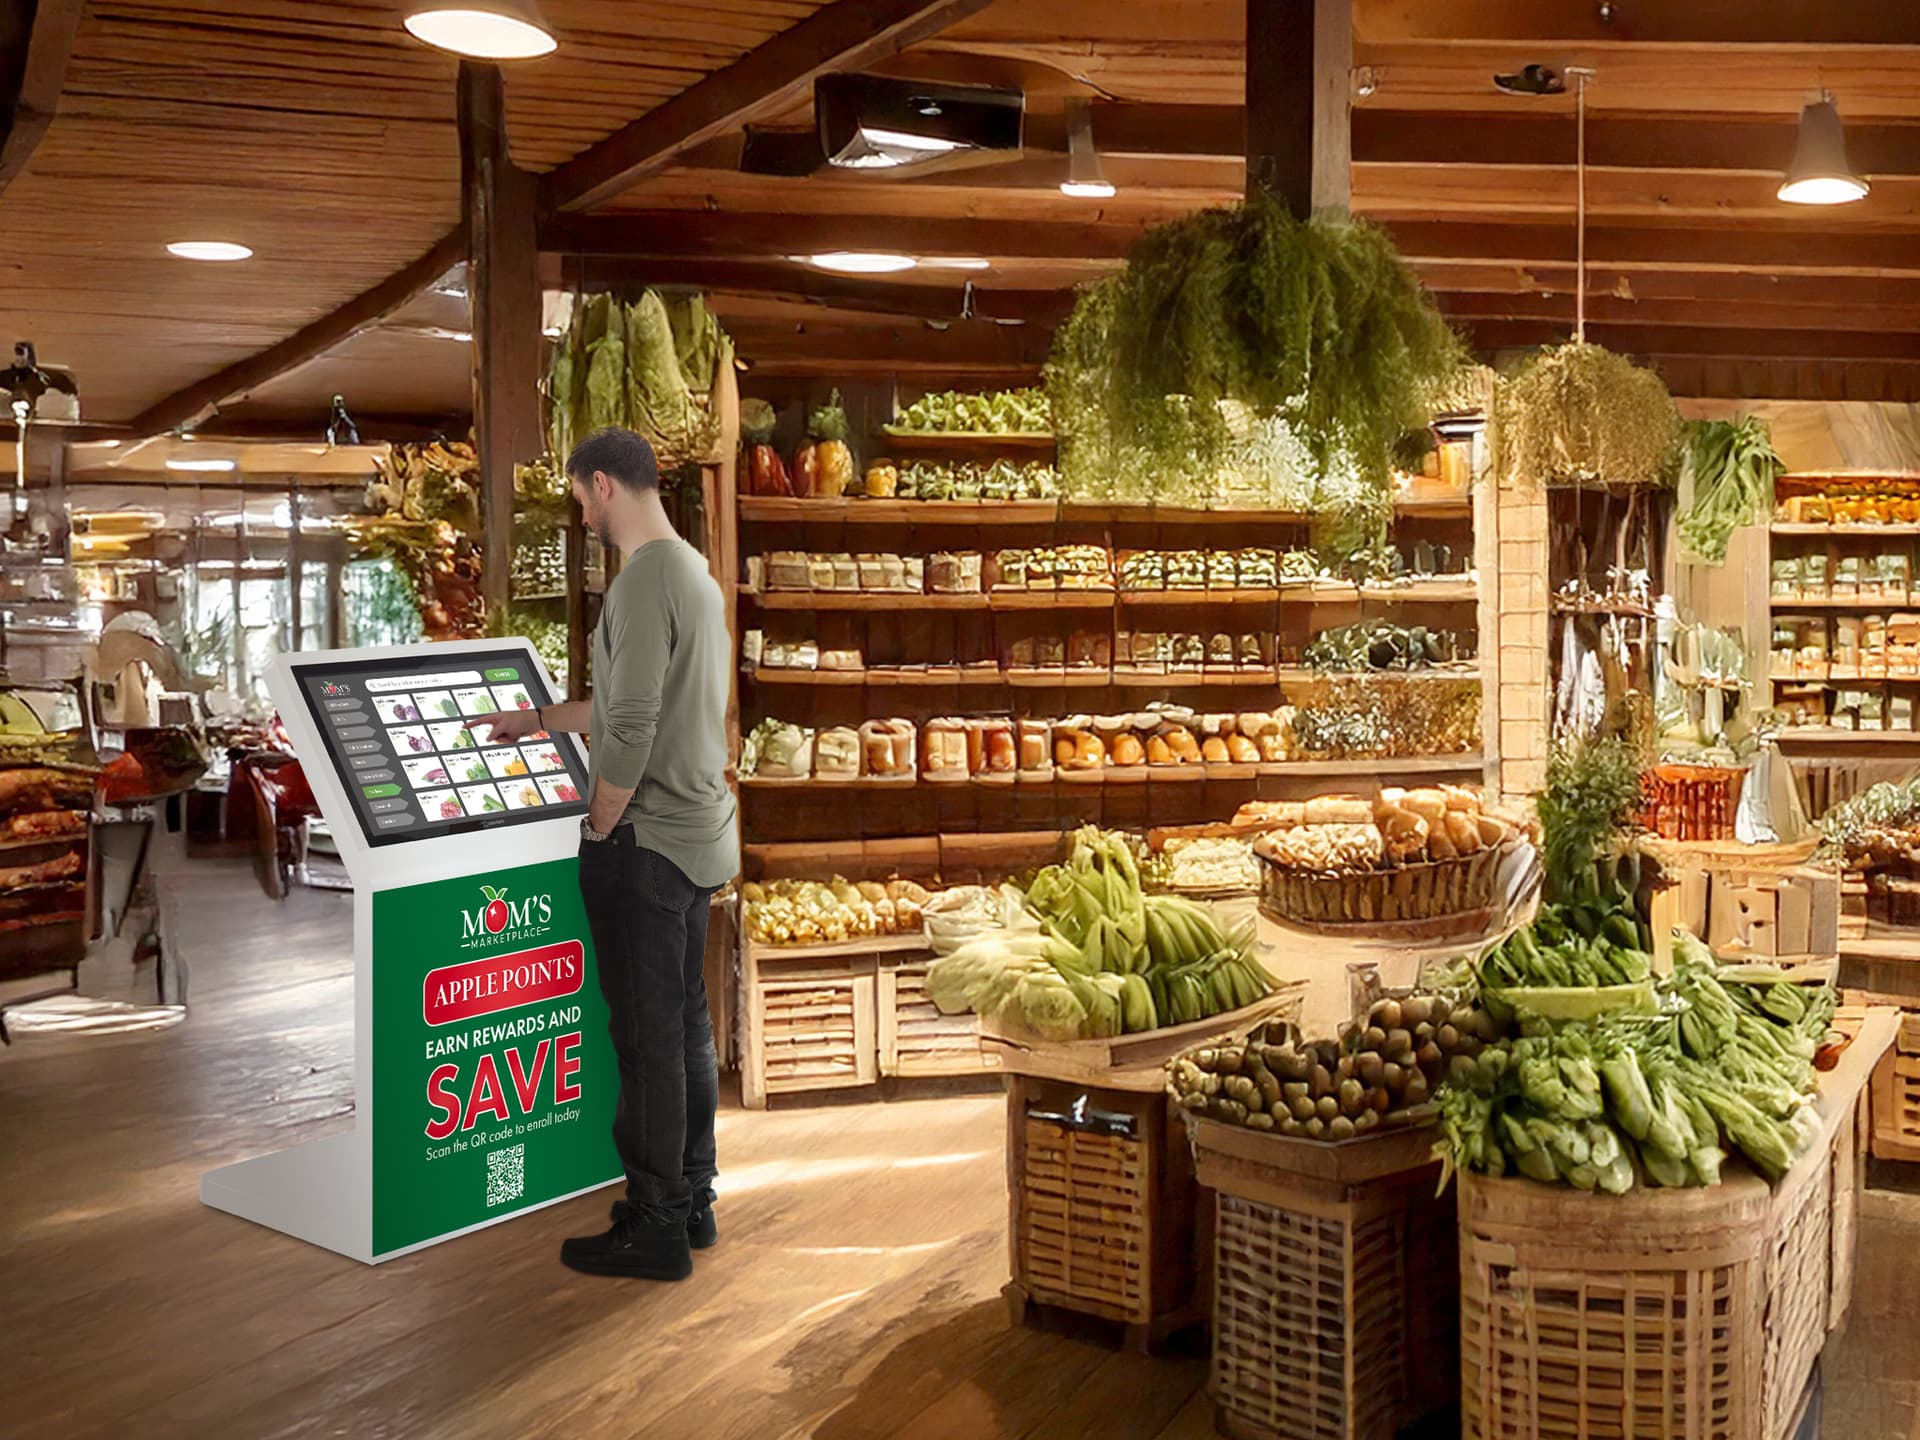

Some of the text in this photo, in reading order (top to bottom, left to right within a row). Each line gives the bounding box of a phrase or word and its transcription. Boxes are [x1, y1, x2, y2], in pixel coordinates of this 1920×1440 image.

[461, 894, 552, 939] MOM'S
[470, 927, 543, 949] MARKETPLACE
[434, 955, 575, 1007] APPLE POINTS
[426, 1006, 581, 1059] EARN REWARDS AND
[424, 1031, 582, 1140] SAVE
[425, 1107, 580, 1161] Scan the QR code to enroll today
